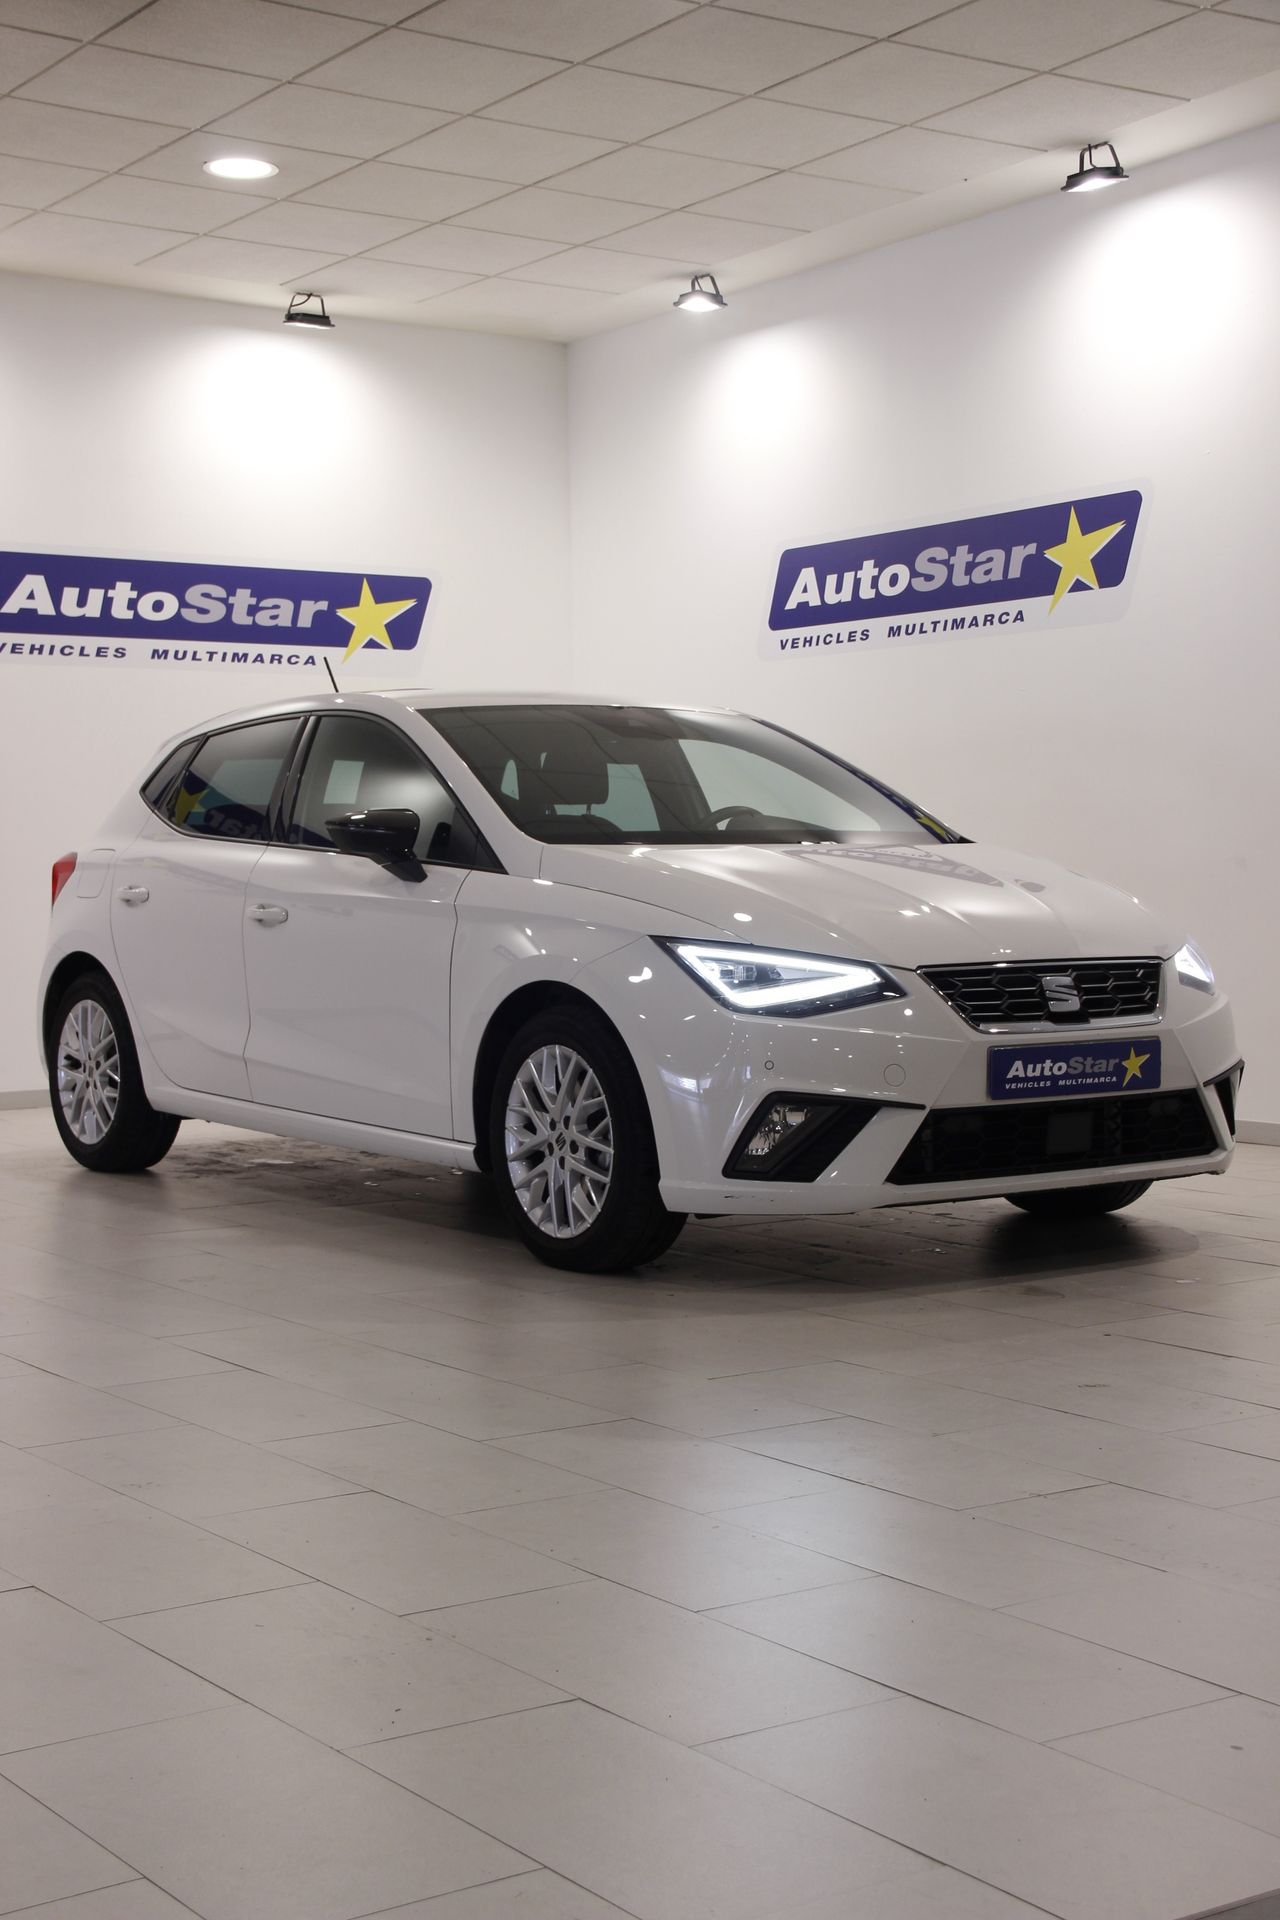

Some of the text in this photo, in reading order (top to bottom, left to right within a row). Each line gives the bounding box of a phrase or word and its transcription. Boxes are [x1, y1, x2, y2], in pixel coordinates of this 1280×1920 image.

[784, 542, 1037, 611] AutoStar
[0, 574, 329, 628] AutoStar
[780, 610, 1025, 650] VEHICLES MULTIMARCA
[151, 648, 317, 666] MULTIMARCA
[1005, 1076, 1117, 1089] VEHICLES MULTIMARCA
[1006, 1056, 1119, 1079] AutoStar
